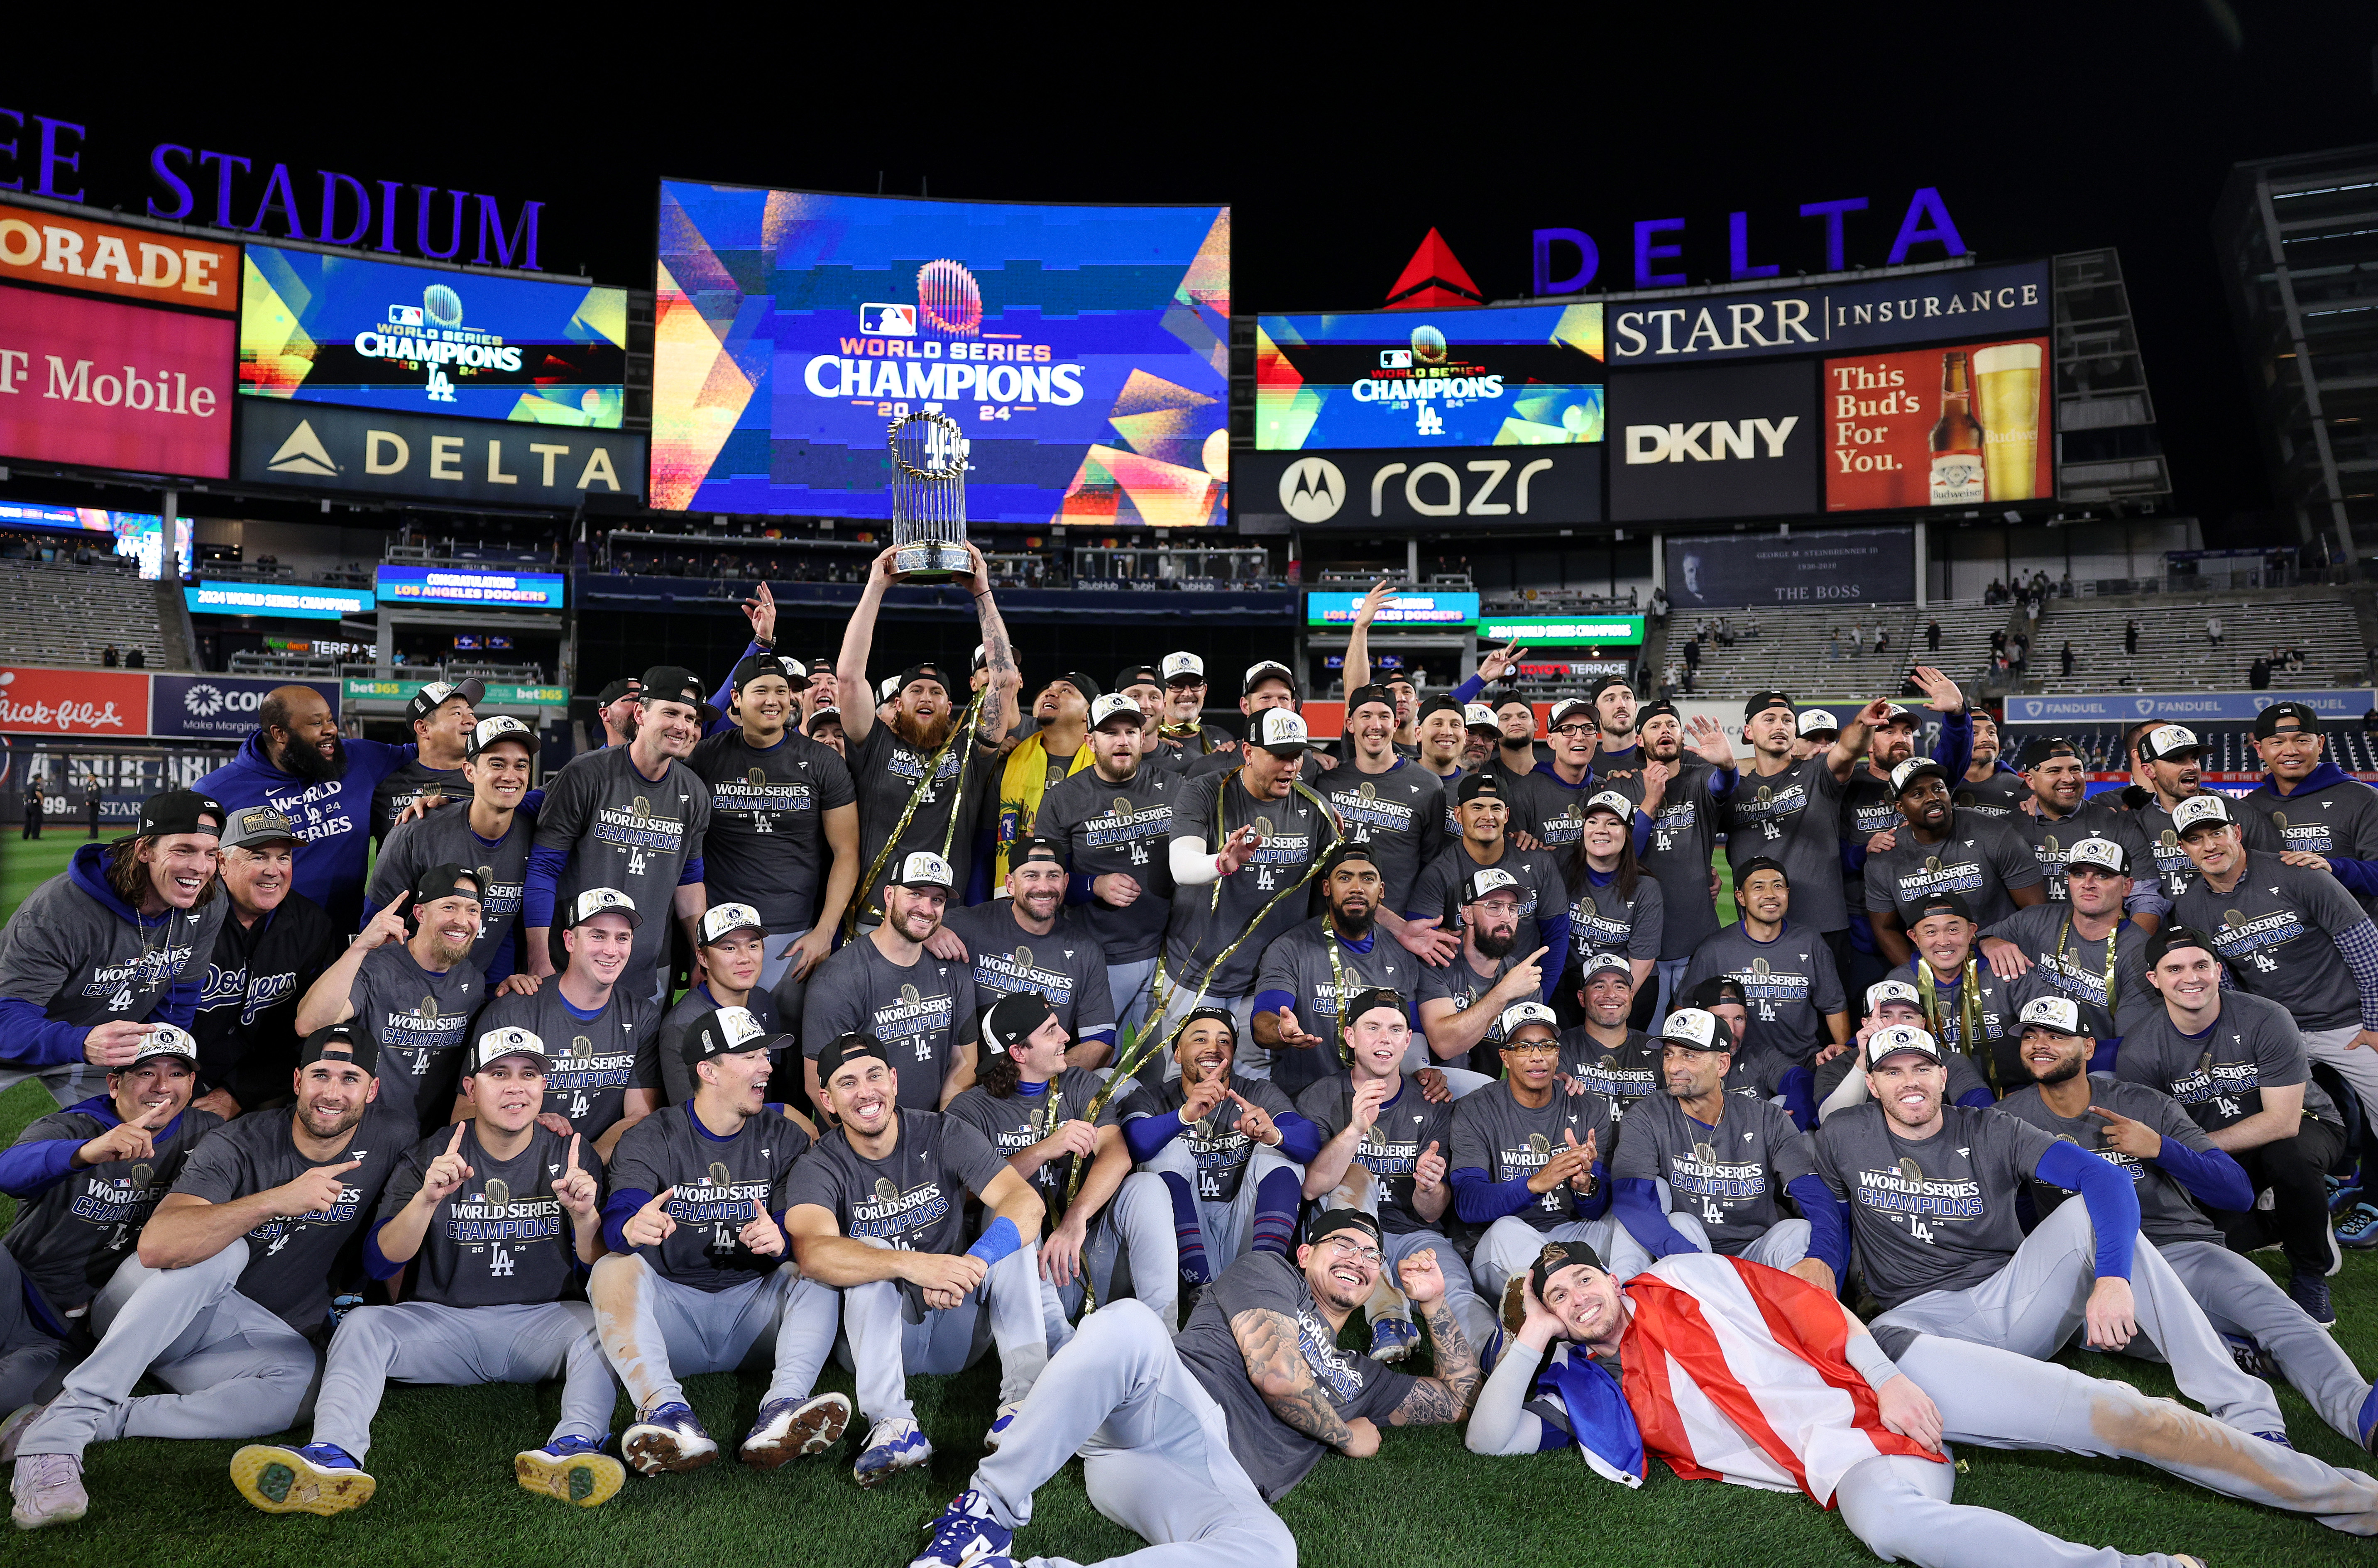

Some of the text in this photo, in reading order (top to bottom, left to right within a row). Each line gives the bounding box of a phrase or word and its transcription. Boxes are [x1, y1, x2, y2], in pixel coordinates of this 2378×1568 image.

[147, 143, 545, 270] STADIUM
[1533, 186, 1968, 297] DELTA
[0, 219, 218, 295] ORADE
[1615, 283, 2039, 357] STARR INSURANCE
[377, 322, 503, 346] WORLD SERIES
[354, 331, 522, 372] CHAMPIONS
[839, 337, 1052, 362] WORLD SERIES
[399, 361, 418, 371] 20
[458, 366, 479, 376] 24
[1370, 368, 1426, 379] WORLD
[1833, 363, 1905, 391] This
[43, 355, 216, 417] Mobile
[426, 362, 455, 401] LA
[804, 354, 1085, 406] CHAMPIONS
[1351, 375, 1504, 402] CHAMPIONS
[877, 401, 909, 417] 20
[979, 405, 1012, 421] 24
[1446, 400, 1465, 409] 24
[1835, 389, 1921, 419] Bud's
[1416, 399, 1443, 436] LA
[1626, 416, 1800, 465] DKNY
[1835, 421, 1889, 446] For
[366, 430, 621, 491] DELTA
[1835, 448, 1903, 474] You.
[1370, 458, 1554, 518] razr
[1933, 488, 1983, 500] Budweiser
[1804, 547, 1867, 557] STEINBRENNER
[427, 573, 516, 589] CONGRATULATIONS
[1079, 580, 1119, 591] StubHub
[1775, 584, 1861, 601] THE BOSS
[198, 590, 361, 612] 2024 WORLD SERIES CHAMPIONS
[395, 585, 547, 602] LOS ANGELES DODGERS
[1324, 610, 1347, 620] LOS
[1404, 610, 1463, 621] DODGERS
[1512, 625, 1546, 638] WORLD
[1576, 624, 1632, 637] CHAMPIONS
[312, 640, 377, 658] TERRAE
[1571, 663, 1627, 675] TERRACE
[350, 681, 399, 694] bet365
[516, 687, 563, 701] bet365
[2045, 703, 2106, 714] FANDUEL
[2158, 701, 2222, 712] FANDUEL
[183, 719, 213, 730] Make
[270, 780, 342, 812] WORLD
[714, 783, 810, 797] WORLD SERIES
[326, 801, 342, 813] 24
[712, 795, 811, 811] CHAMPIONS
[1331, 791, 1412, 818] WORLD SERIES
[1735, 801, 1771, 813] WORLD
[246, 821, 274, 832] WORLD
[297, 815, 353, 842] ERIES
[599, 809, 684, 835] WORLD SERIES
[754, 811, 773, 833] LA
[1084, 806, 1173, 832] WORLD SERIES
[1761, 818, 1782, 840] LA
[594, 822, 681, 851] CHAMPIONS
[1086, 818, 1173, 847] CHAMPIONS
[1271, 836, 1309, 848] SERIES
[628, 846, 646, 875] LA
[1128, 840, 1150, 866] LA
[1899, 863, 1980, 889] WORLD SERIES
[2212, 911, 2298, 946] WORLD SERIES
[2216, 922, 2305, 957] CHAMPIONS
[978, 954, 1073, 989] WORLD SERIES
[2253, 950, 2279, 973] LA
[1722, 974, 1809, 987] WORLD SERIES
[387, 1013, 469, 1031] WORLD SERIES
[1758, 999, 1776, 1022] LA
[382, 1027, 466, 1046] CHAMPIONS
[411, 1048, 431, 1075] LA
[1672, 1157, 1763, 1179] WORLD SERIES
[1671, 1170, 1766, 1197] CHAMPIONS
[1858, 1170, 1980, 1197] WORLD SERIES
[450, 1202, 560, 1220] WORLD SERIES
[1701, 1196, 1725, 1224] LA
[1857, 1186, 1984, 1216] CHAMPIONS
[445, 1216, 560, 1240] CHAMPIONS
[1909, 1214, 1935, 1245] LA
[489, 1242, 515, 1277] LA
